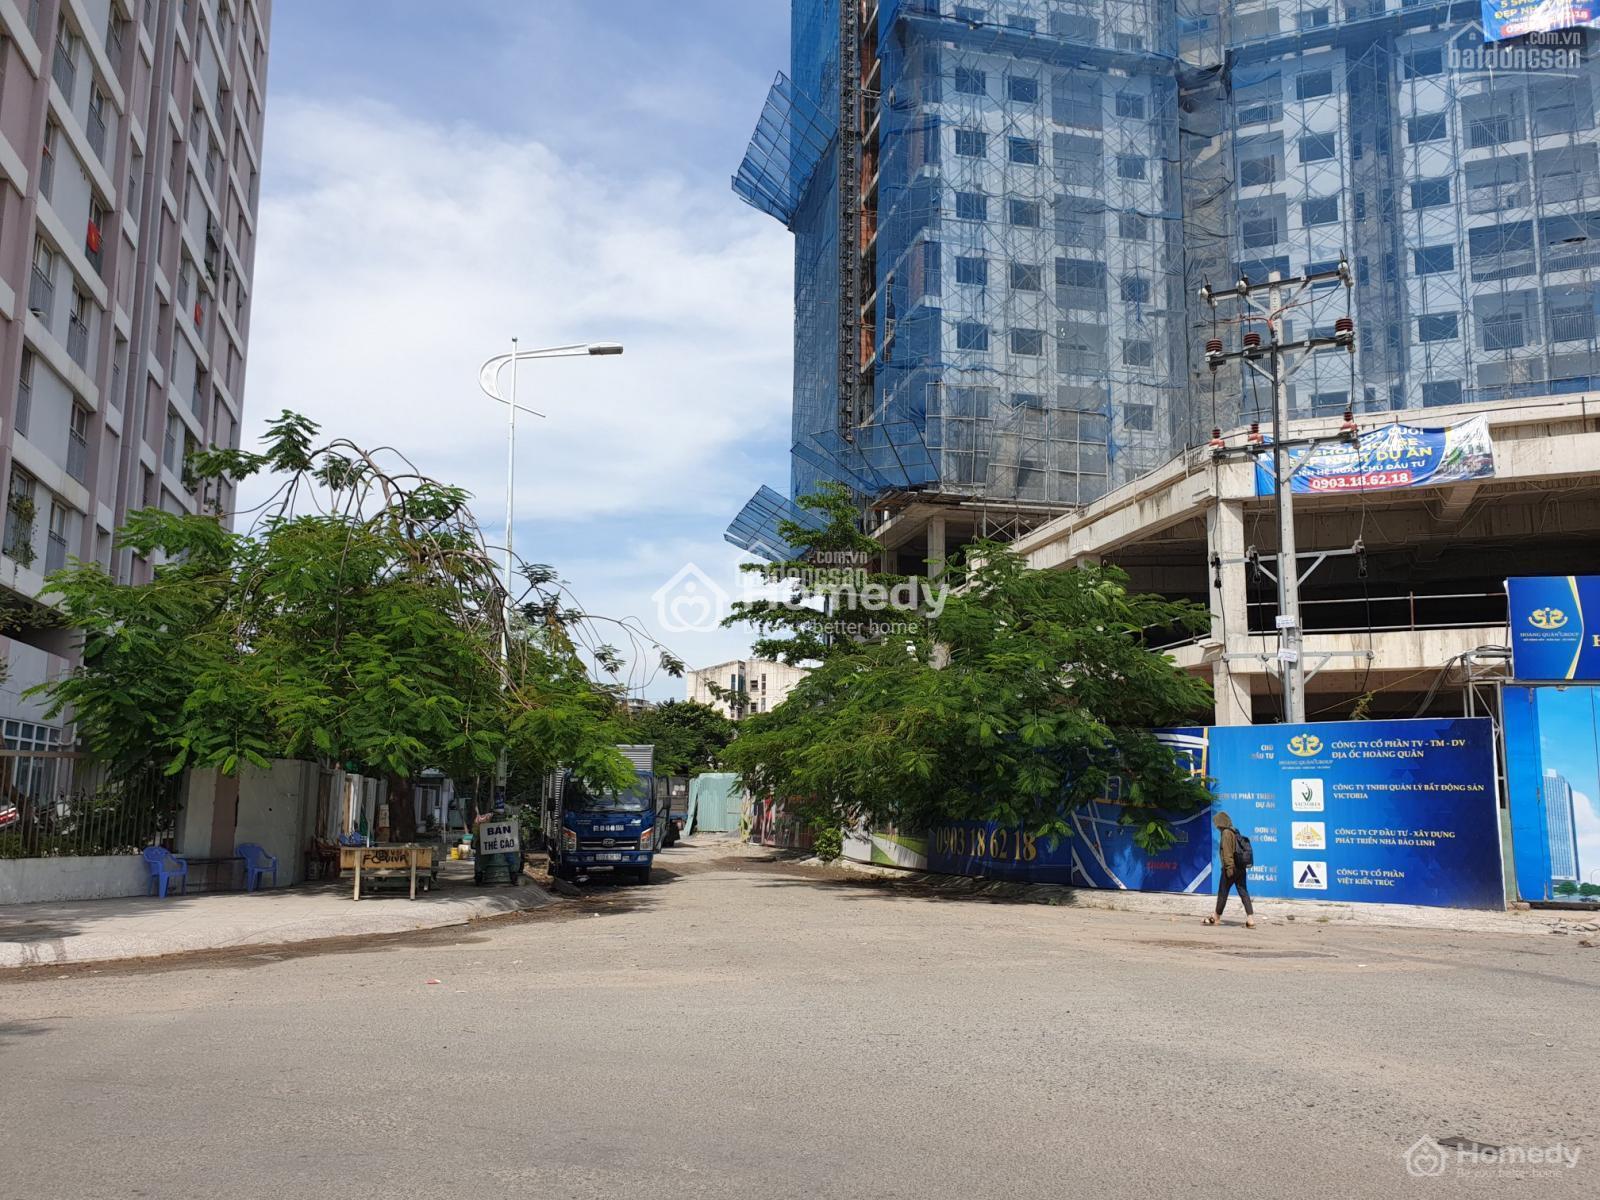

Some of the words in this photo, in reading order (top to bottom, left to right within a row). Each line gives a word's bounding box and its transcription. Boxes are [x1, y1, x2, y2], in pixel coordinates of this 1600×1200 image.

[1312, 473, 1408, 489] 0903.18.62.18
[1331, 740, 1357, 749] CÔNG
[1363, 749, 1396, 758] HOÀNG
[1335, 827, 1357, 836] CÔNG
[1413, 829, 1430, 837] XÂY
[936, 825, 965, 856] 0903
[970, 827, 986, 857] 18
[990, 828, 1008, 858] 62
[1013, 830, 1037, 861] 18
[1336, 868, 1359, 876] CÔNG
